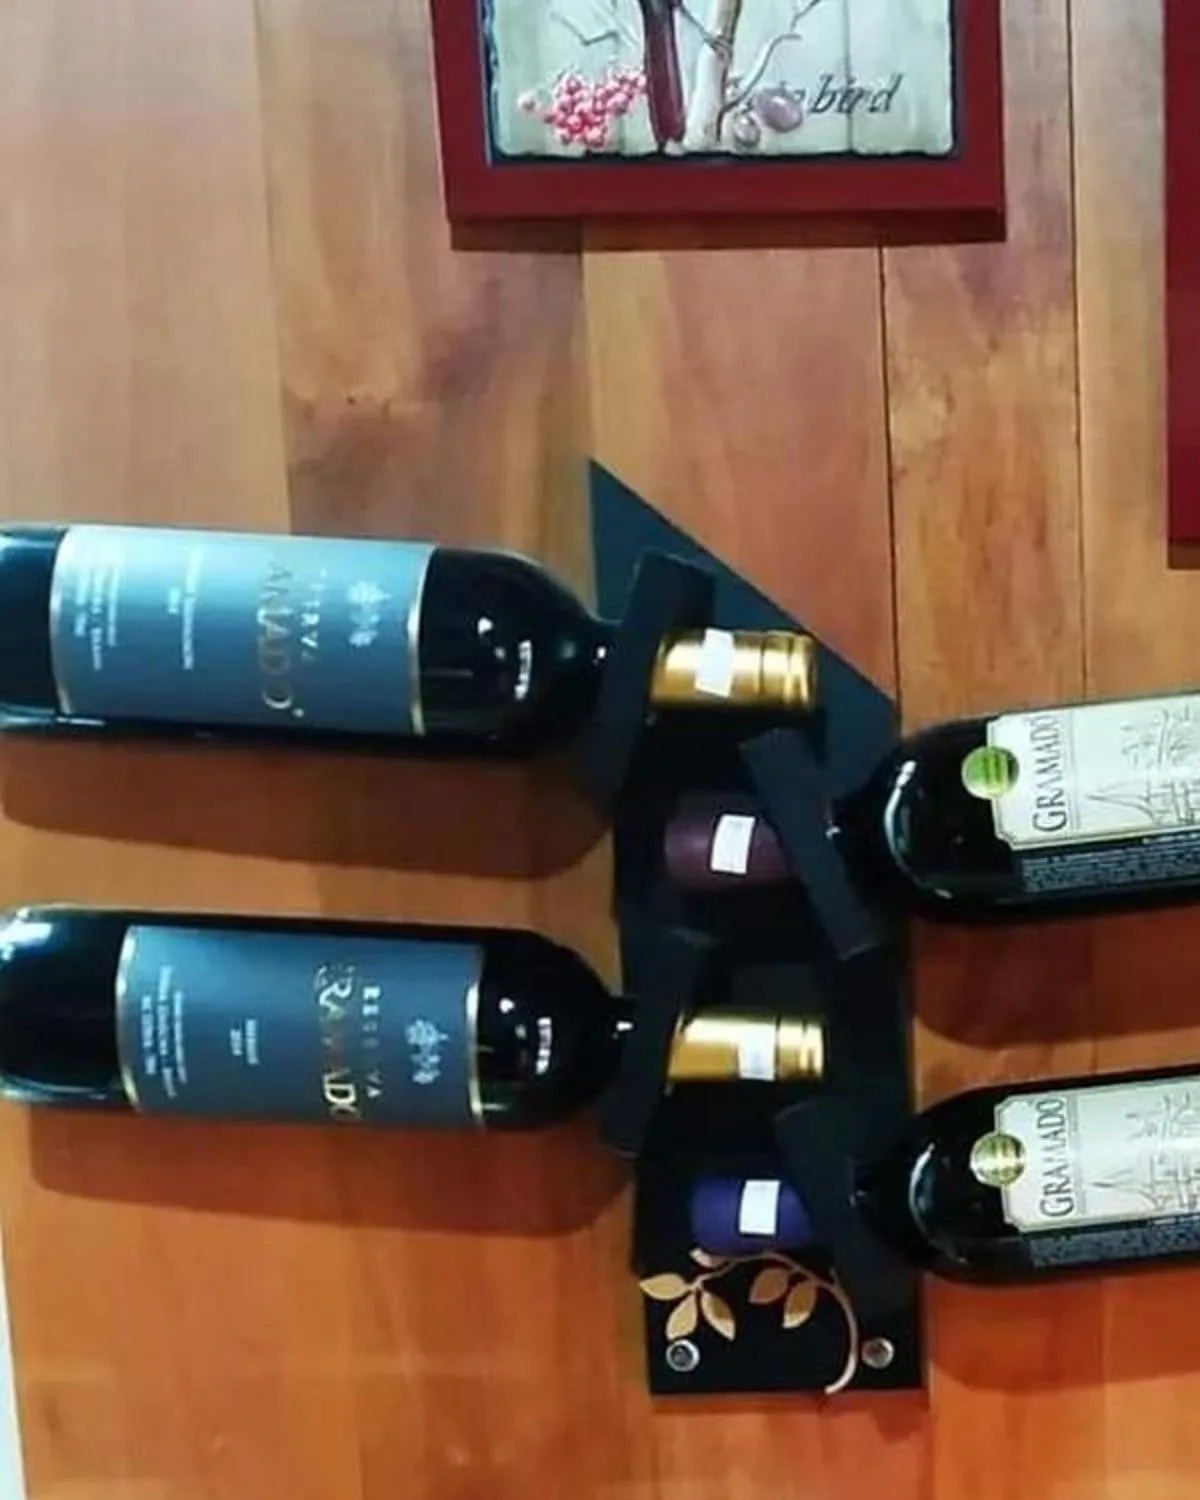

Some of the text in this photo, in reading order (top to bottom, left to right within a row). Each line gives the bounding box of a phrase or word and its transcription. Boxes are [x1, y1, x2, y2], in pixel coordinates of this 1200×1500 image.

[808, 72, 905, 114] bird
[1032, 712, 1068, 834] GRAMADO
[1038, 1097, 1075, 1219] GRAMADO
